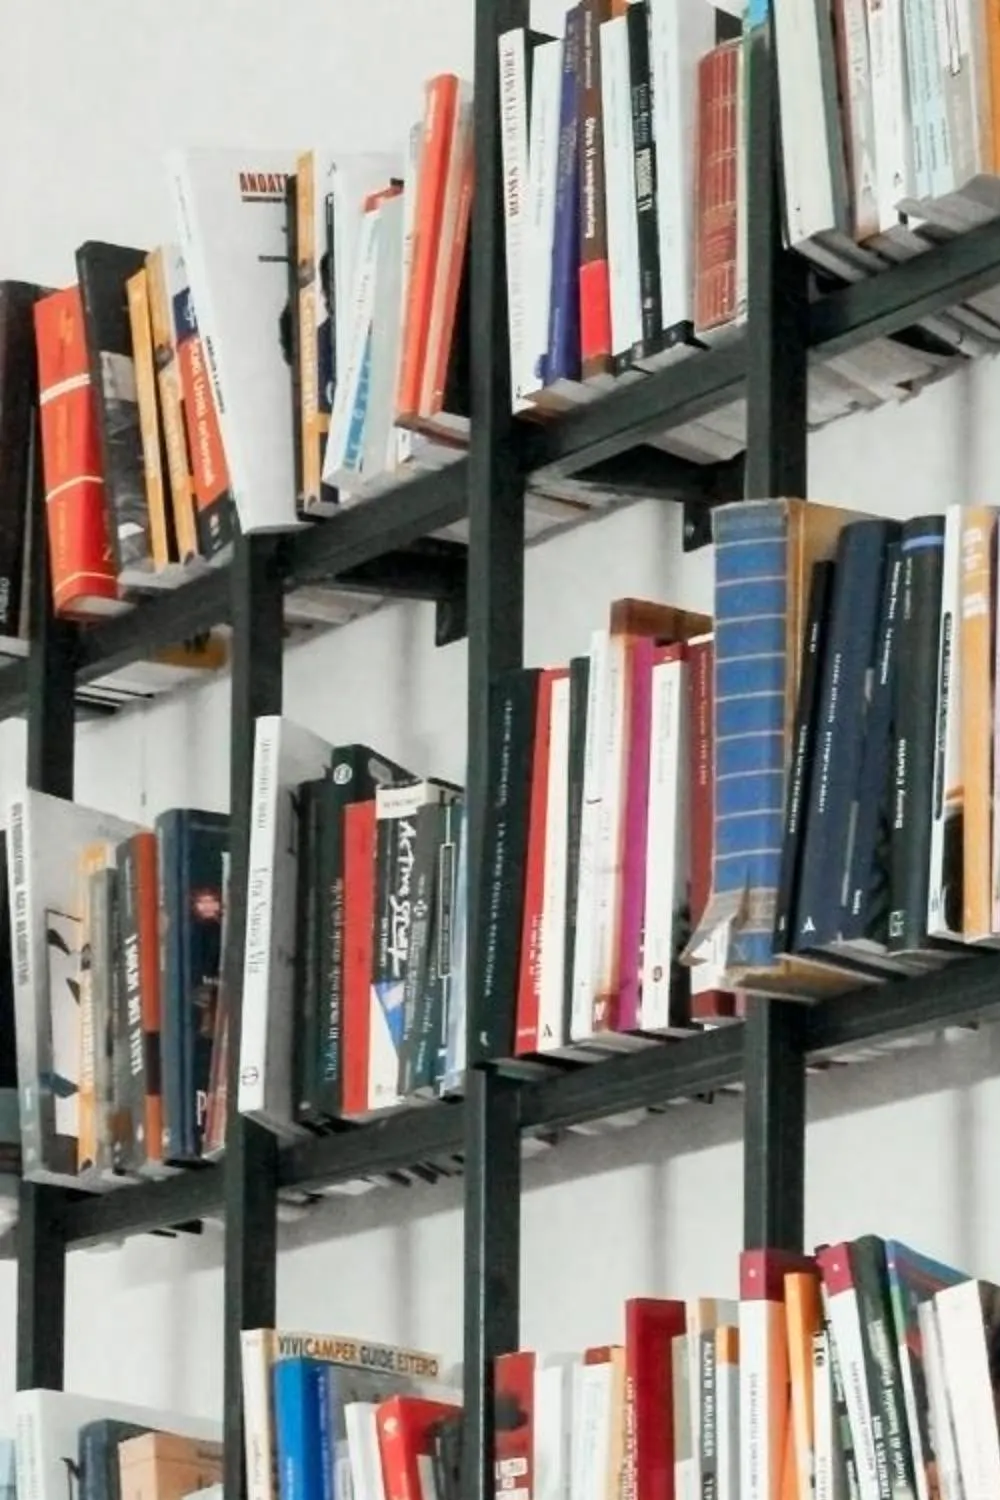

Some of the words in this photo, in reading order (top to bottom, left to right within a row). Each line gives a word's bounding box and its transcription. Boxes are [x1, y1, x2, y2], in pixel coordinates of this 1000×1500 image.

[276, 1335, 358, 1363] VIVICAMPER
[360, 1345, 395, 1372] GUIDE
[397, 1353, 439, 1378] ESTERO
[701, 1341, 713, 1376] ALAN
[702, 1394, 714, 1458] KRUEGER
